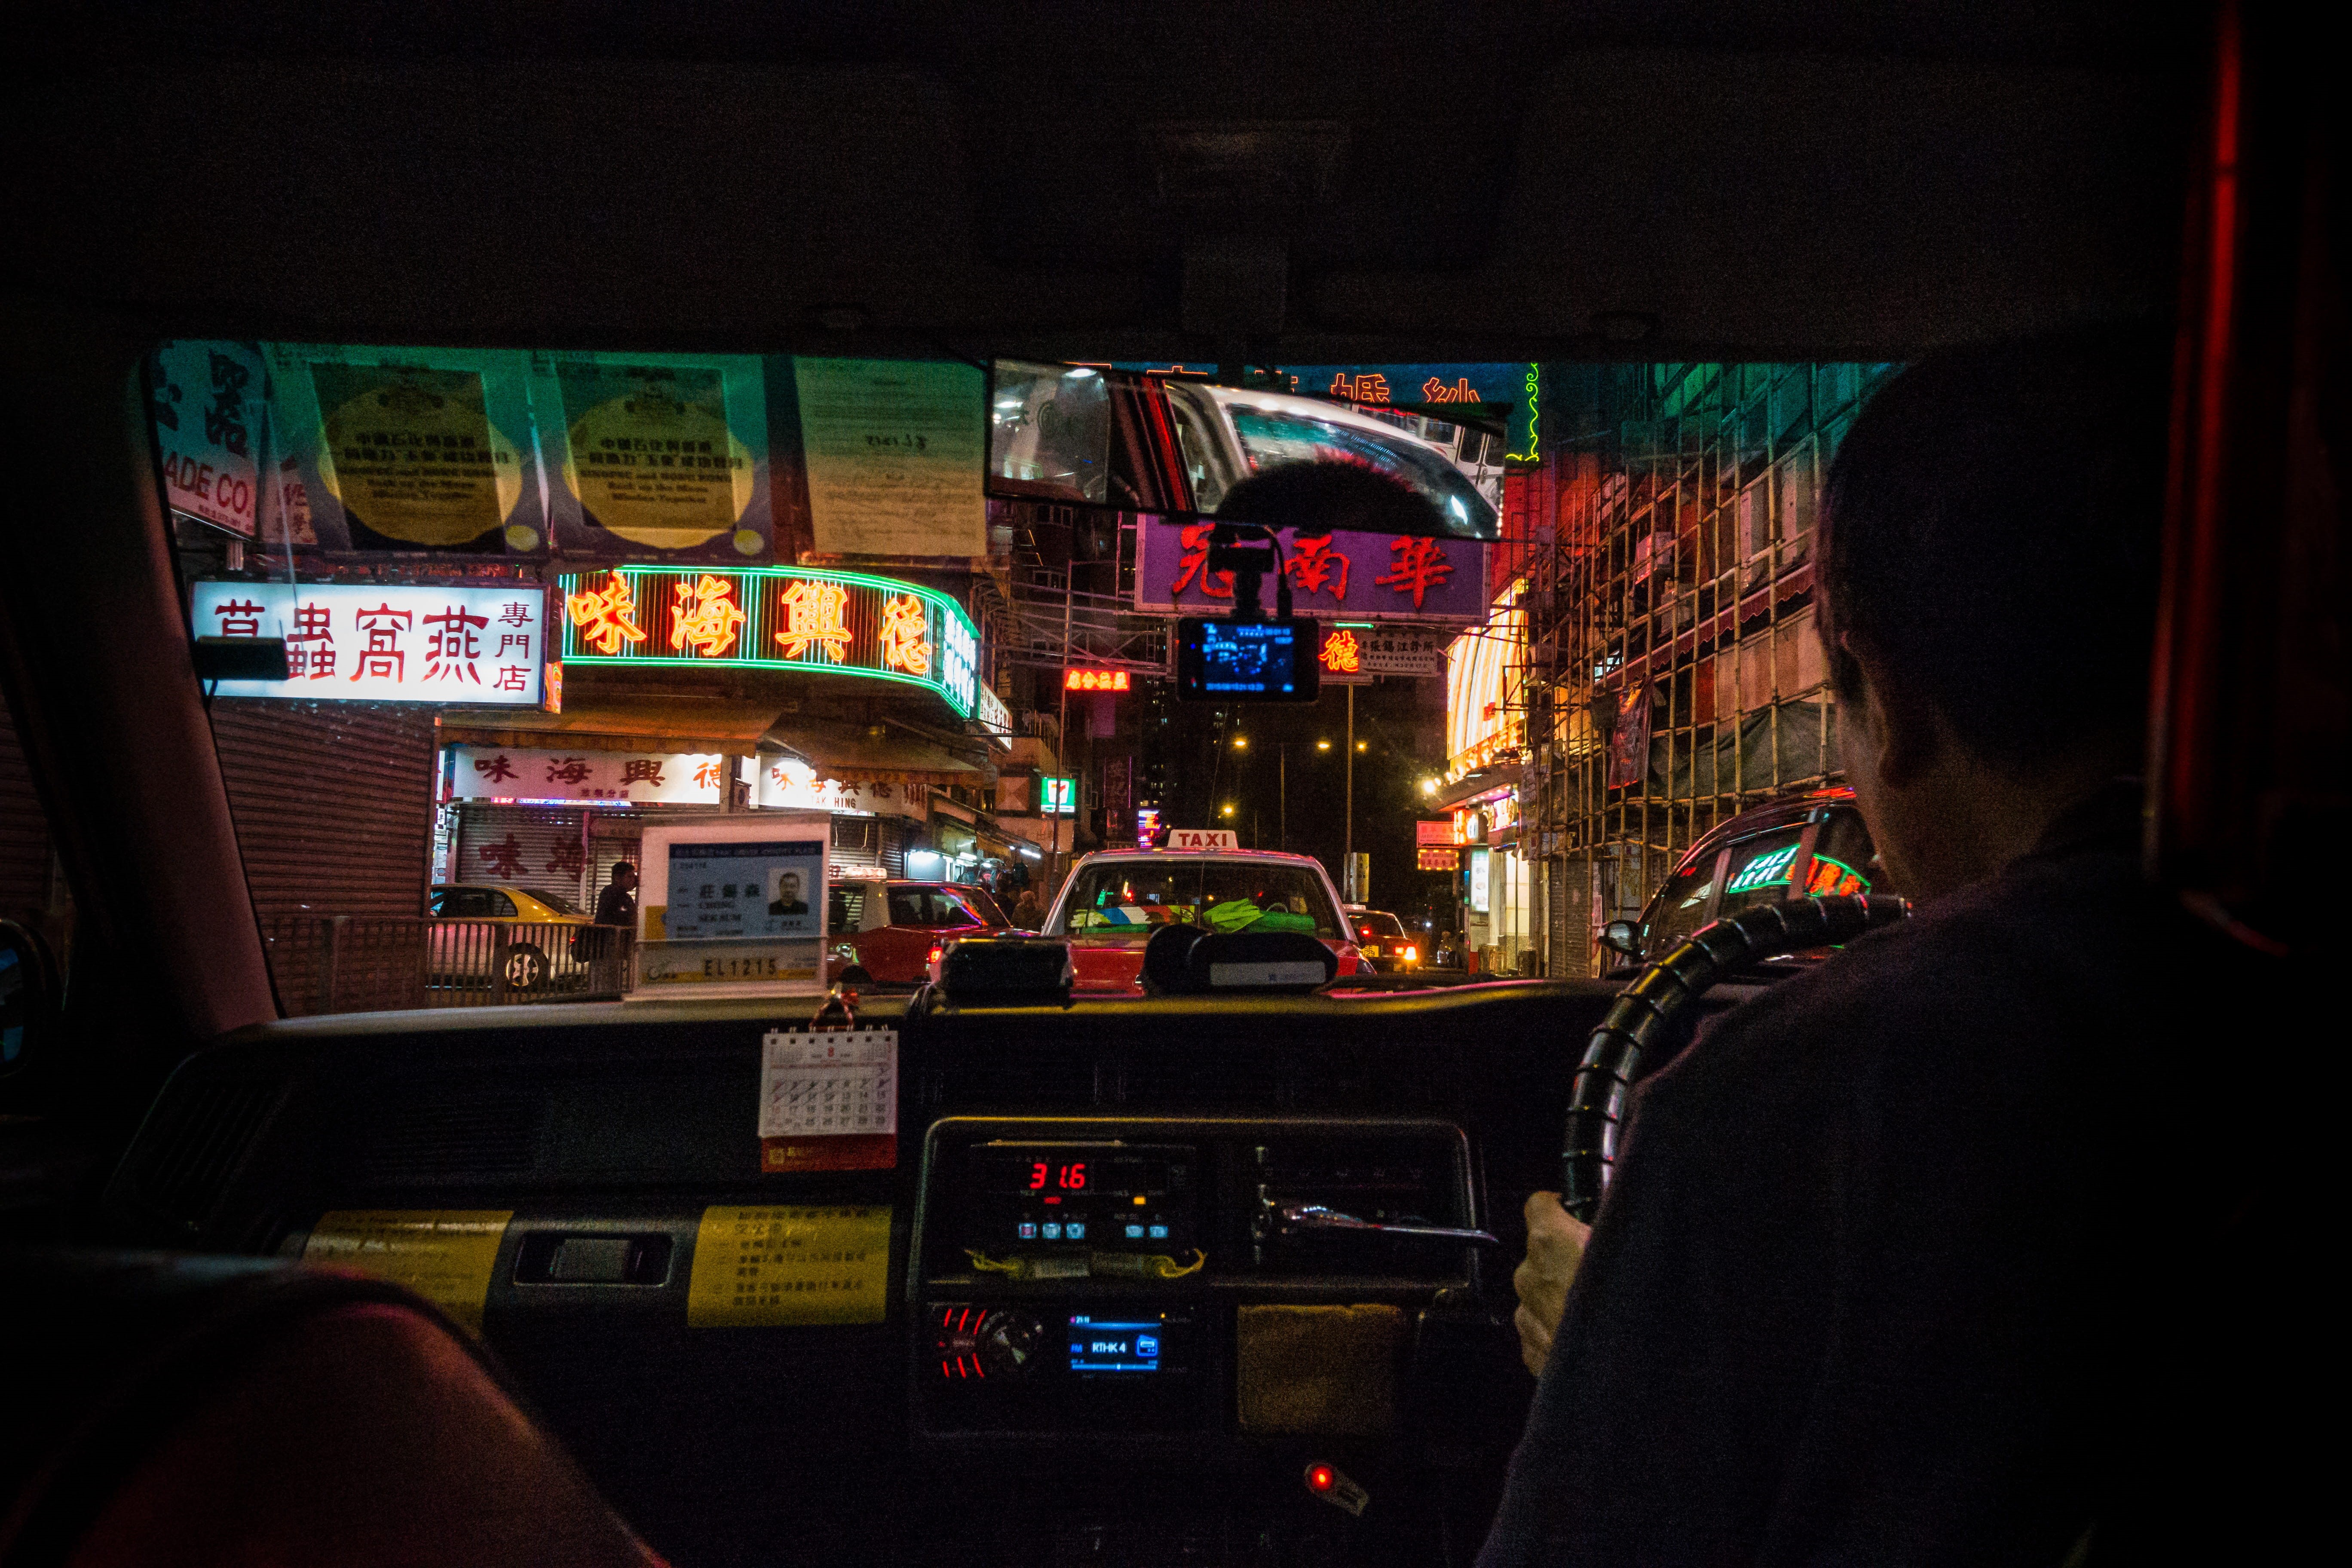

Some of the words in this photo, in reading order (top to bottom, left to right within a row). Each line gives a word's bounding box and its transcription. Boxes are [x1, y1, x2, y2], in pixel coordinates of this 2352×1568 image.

[164, 450, 213, 501] ADE
[834, 797, 857, 808] HING
[1178, 833, 1228, 846] TAXI
[704, 958, 776, 977] EL1215
[1092, 1342, 1118, 1353] RTHK
[1119, 1342, 1126, 1353] 4
